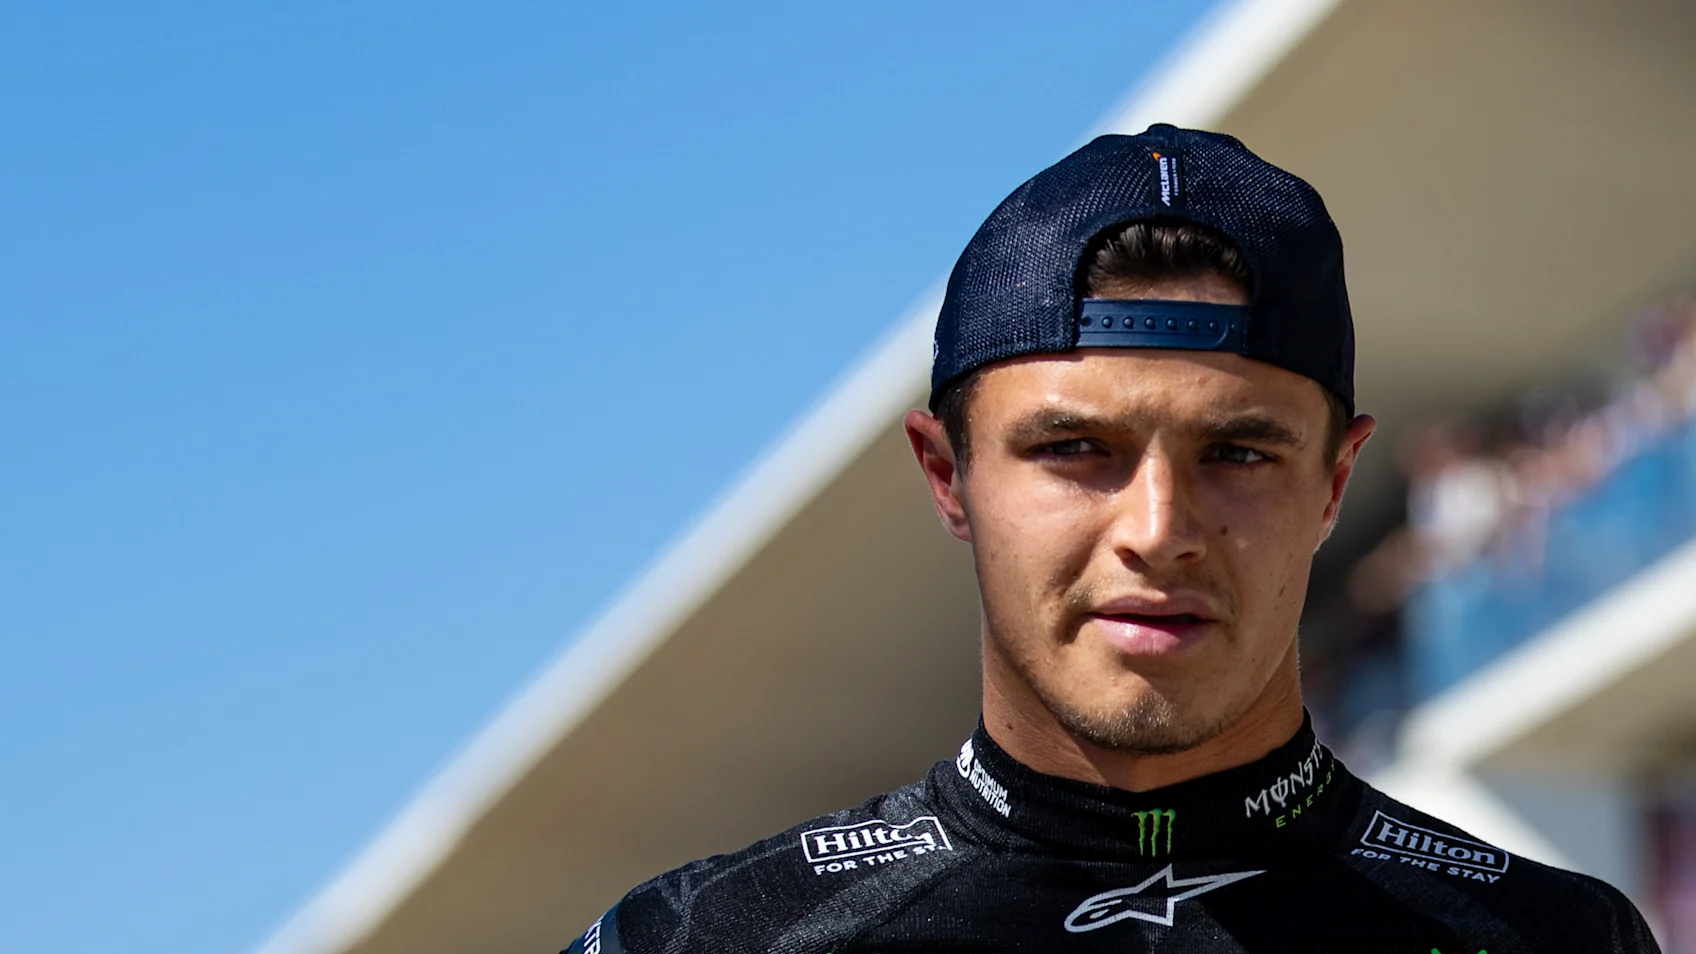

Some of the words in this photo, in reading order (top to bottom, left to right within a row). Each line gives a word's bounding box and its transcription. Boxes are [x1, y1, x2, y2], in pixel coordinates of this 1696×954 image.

[1160, 157, 1171, 207] McLaren
[969, 769, 1012, 818] NUTRITION
[973, 758, 1008, 801] OPTIMUM
[813, 860, 859, 876] FOR
[862, 850, 908, 866] THE
[1376, 821, 1496, 865] Hilton
[1350, 848, 1392, 861] FOR
[1399, 856, 1441, 872] THE
[1446, 867, 1500, 884] STAY
